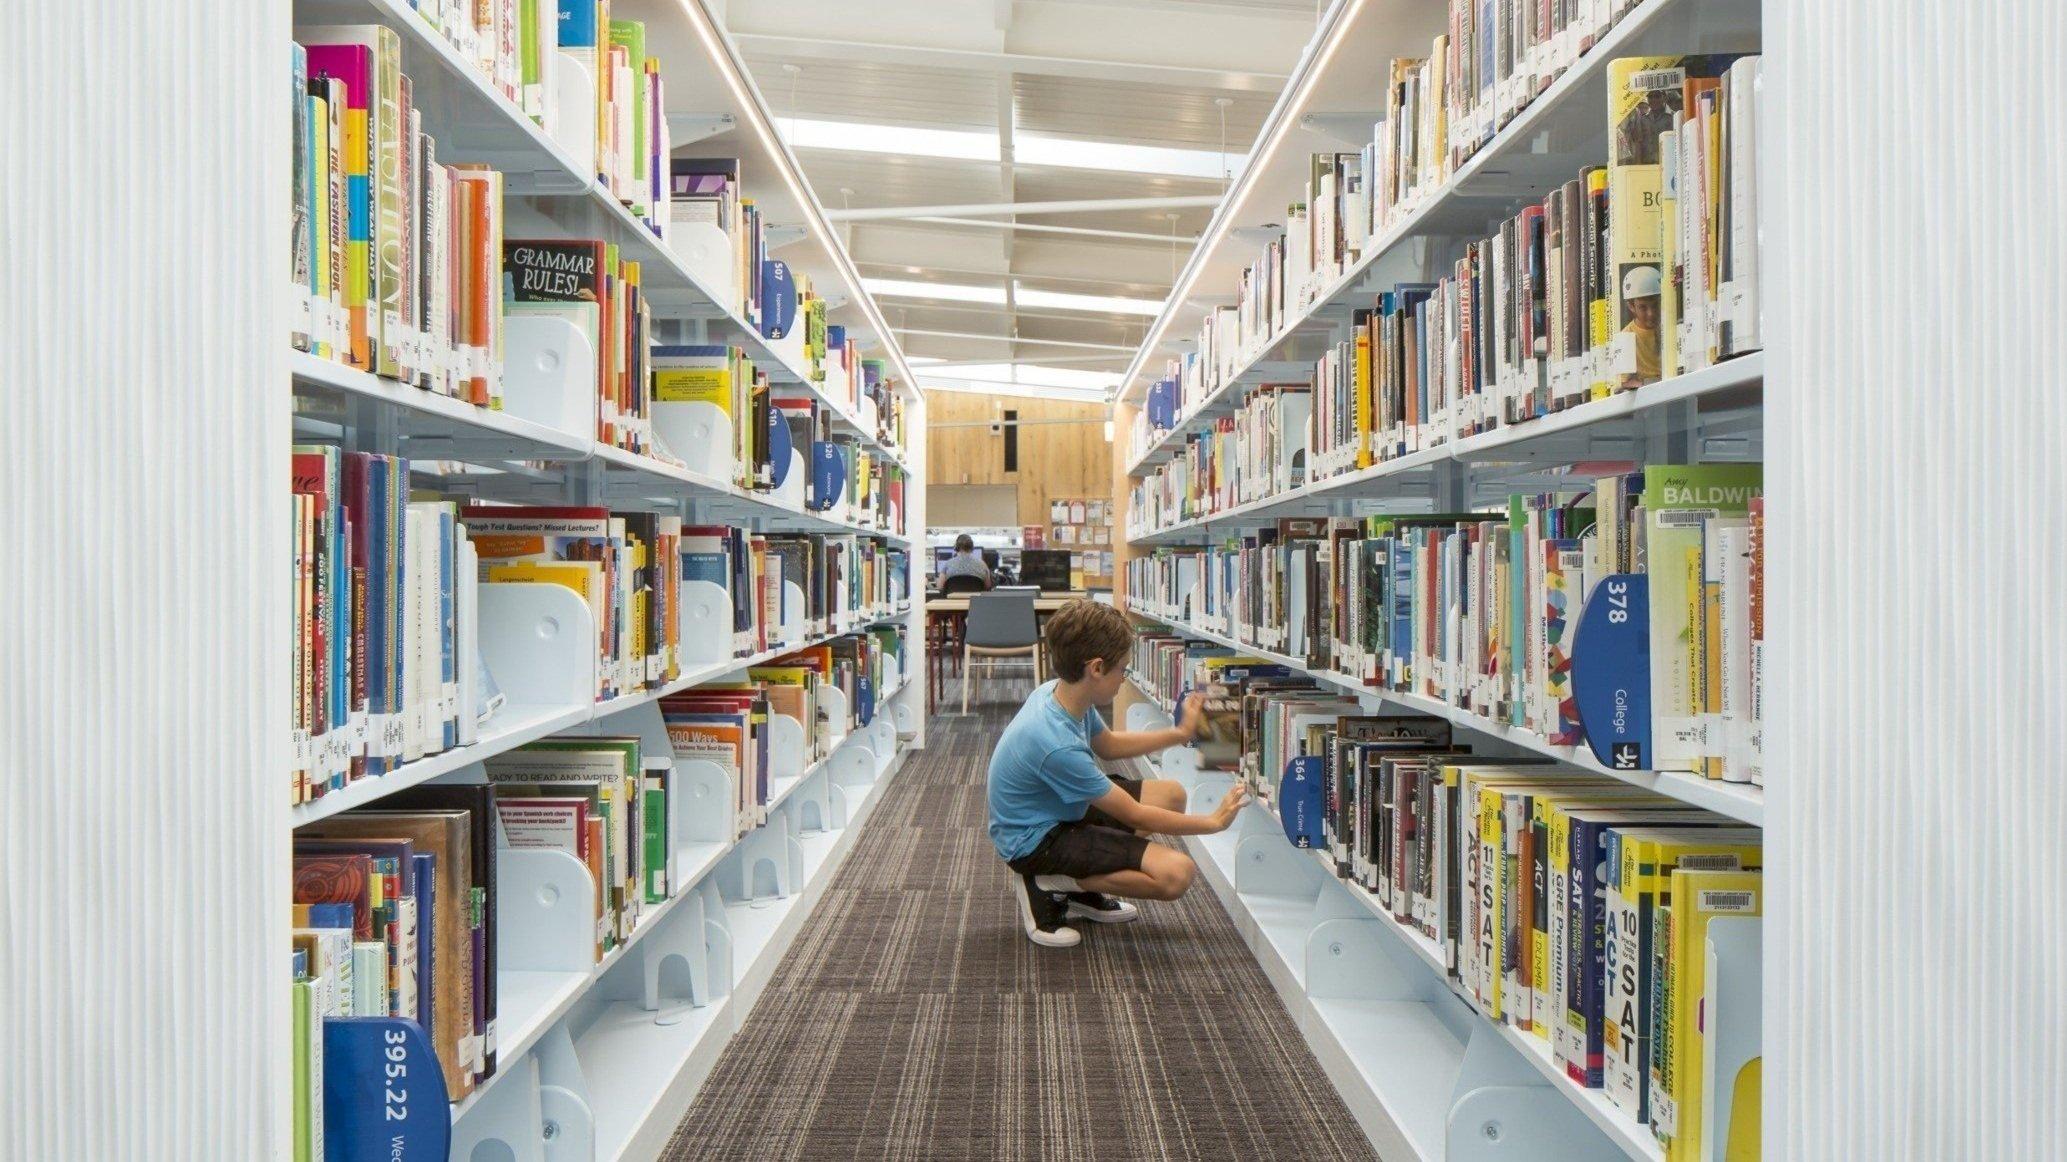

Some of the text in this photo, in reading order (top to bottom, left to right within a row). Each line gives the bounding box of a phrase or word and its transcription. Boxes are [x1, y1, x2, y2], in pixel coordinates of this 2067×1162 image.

[331, 148, 340, 292] THE FASHION BOOK
[380, 96, 401, 305] FASHION
[514, 247, 594, 275] GRAMMAR
[523, 268, 579, 295] RULES!
[774, 263, 783, 281] 507
[1589, 247, 1597, 288] Security
[769, 409, 777, 426] 510
[825, 443, 833, 459] 520
[1664, 478, 1688, 490] Amy
[467, 522, 489, 532] Tough
[491, 523, 505, 531] Test
[507, 522, 542, 532] Questions?
[544, 524, 567, 532] Missed
[1608, 581, 1627, 623] 378
[1612, 689, 1627, 734] College
[692, 731, 719, 743] Ways
[488, 774, 513, 783] EADY
[515, 774, 528, 782] TO
[531, 774, 557, 782] READ
[584, 775, 619, 783] WRITE?
[1296, 759, 1305, 781] 364
[1467, 831, 1477, 897] ACT
[1483, 845, 1493, 864] 11
[1535, 859, 1543, 893] ACT
[1572, 867, 1582, 911] SAT
[1482, 885, 1494, 966] SAT
[1621, 909, 1637, 936] 10
[1535, 940, 1543, 990] DUMMIE
[1556, 916, 1564, 993] Premium
[1606, 910, 1618, 997] ACT
[1620, 963, 1637, 1065] SAT
[313, 1042, 321, 1092] green
[385, 1029, 407, 1121] 395.22
